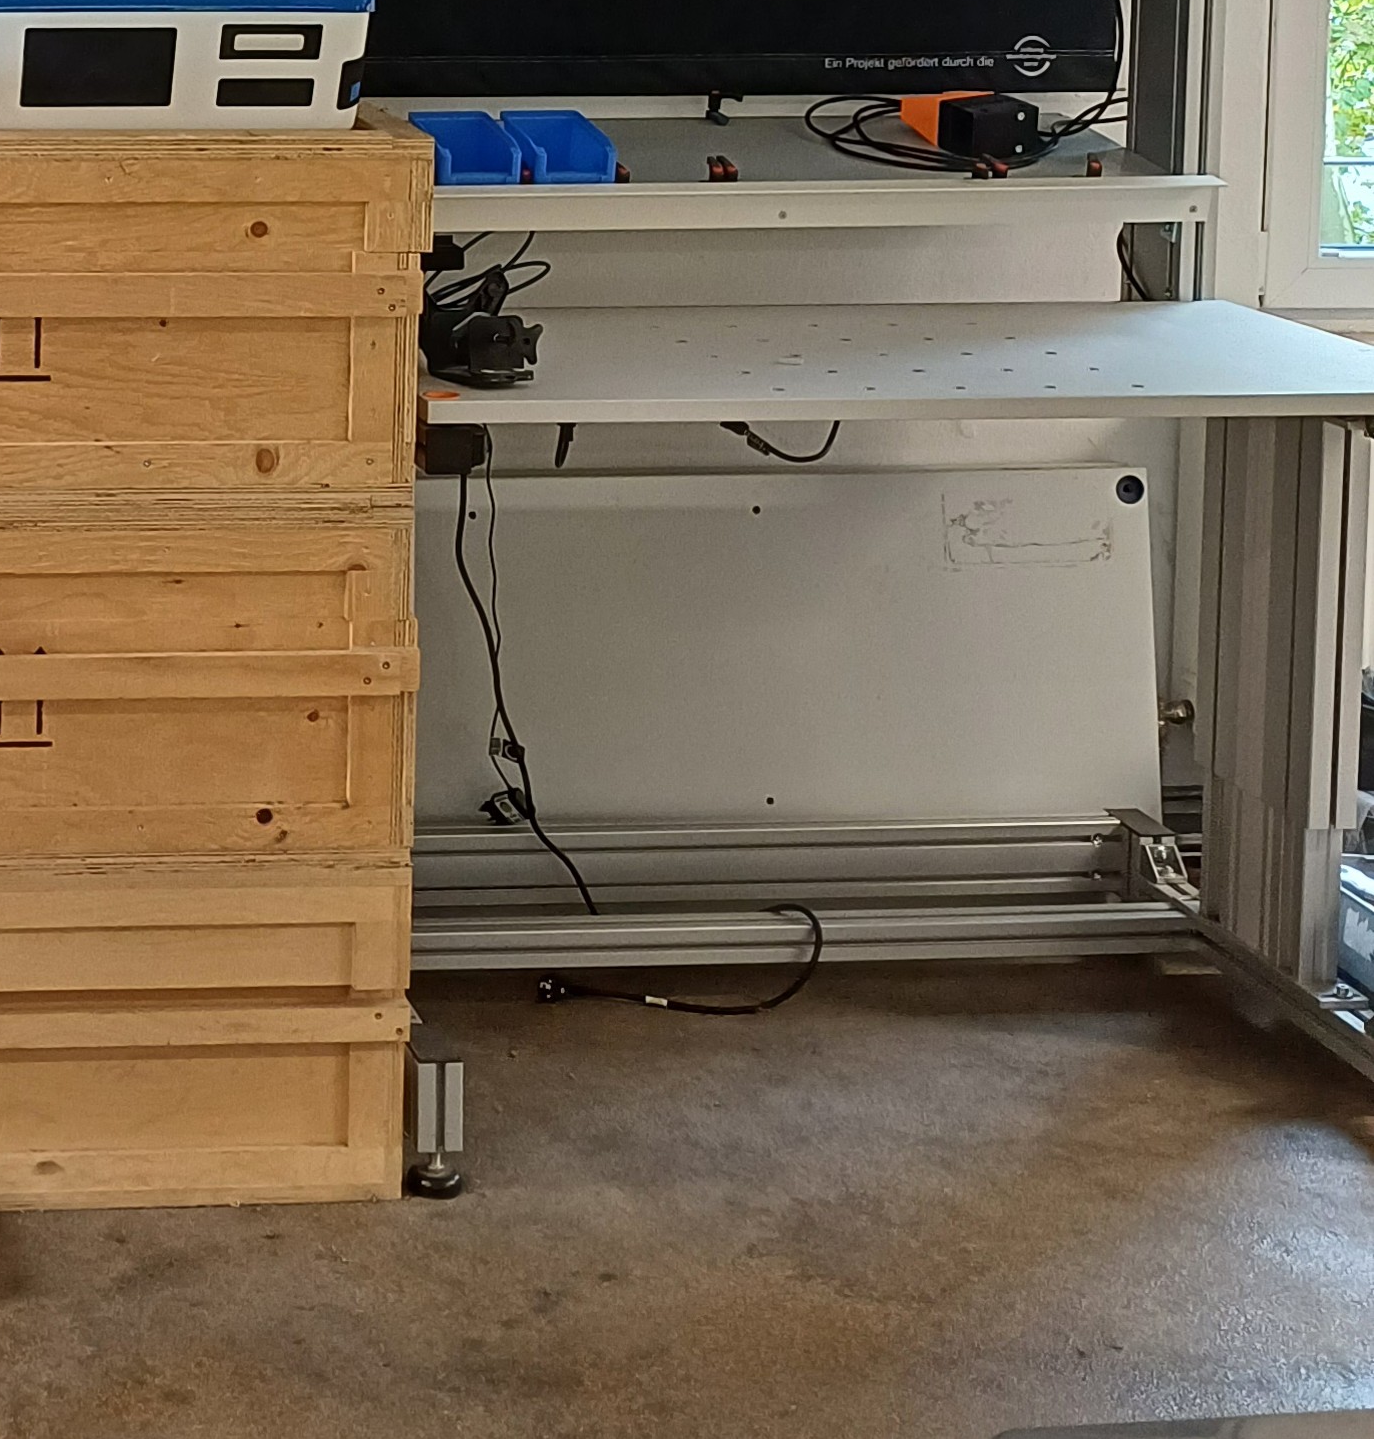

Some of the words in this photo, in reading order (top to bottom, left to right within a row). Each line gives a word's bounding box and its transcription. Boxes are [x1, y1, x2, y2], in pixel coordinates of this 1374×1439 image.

[825, 58, 842, 68] Ein
[845, 58, 884, 70] Projekt
[888, 57, 939, 70] gefördert
[941, 56, 974, 67] durch
[976, 56, 994, 67] die
